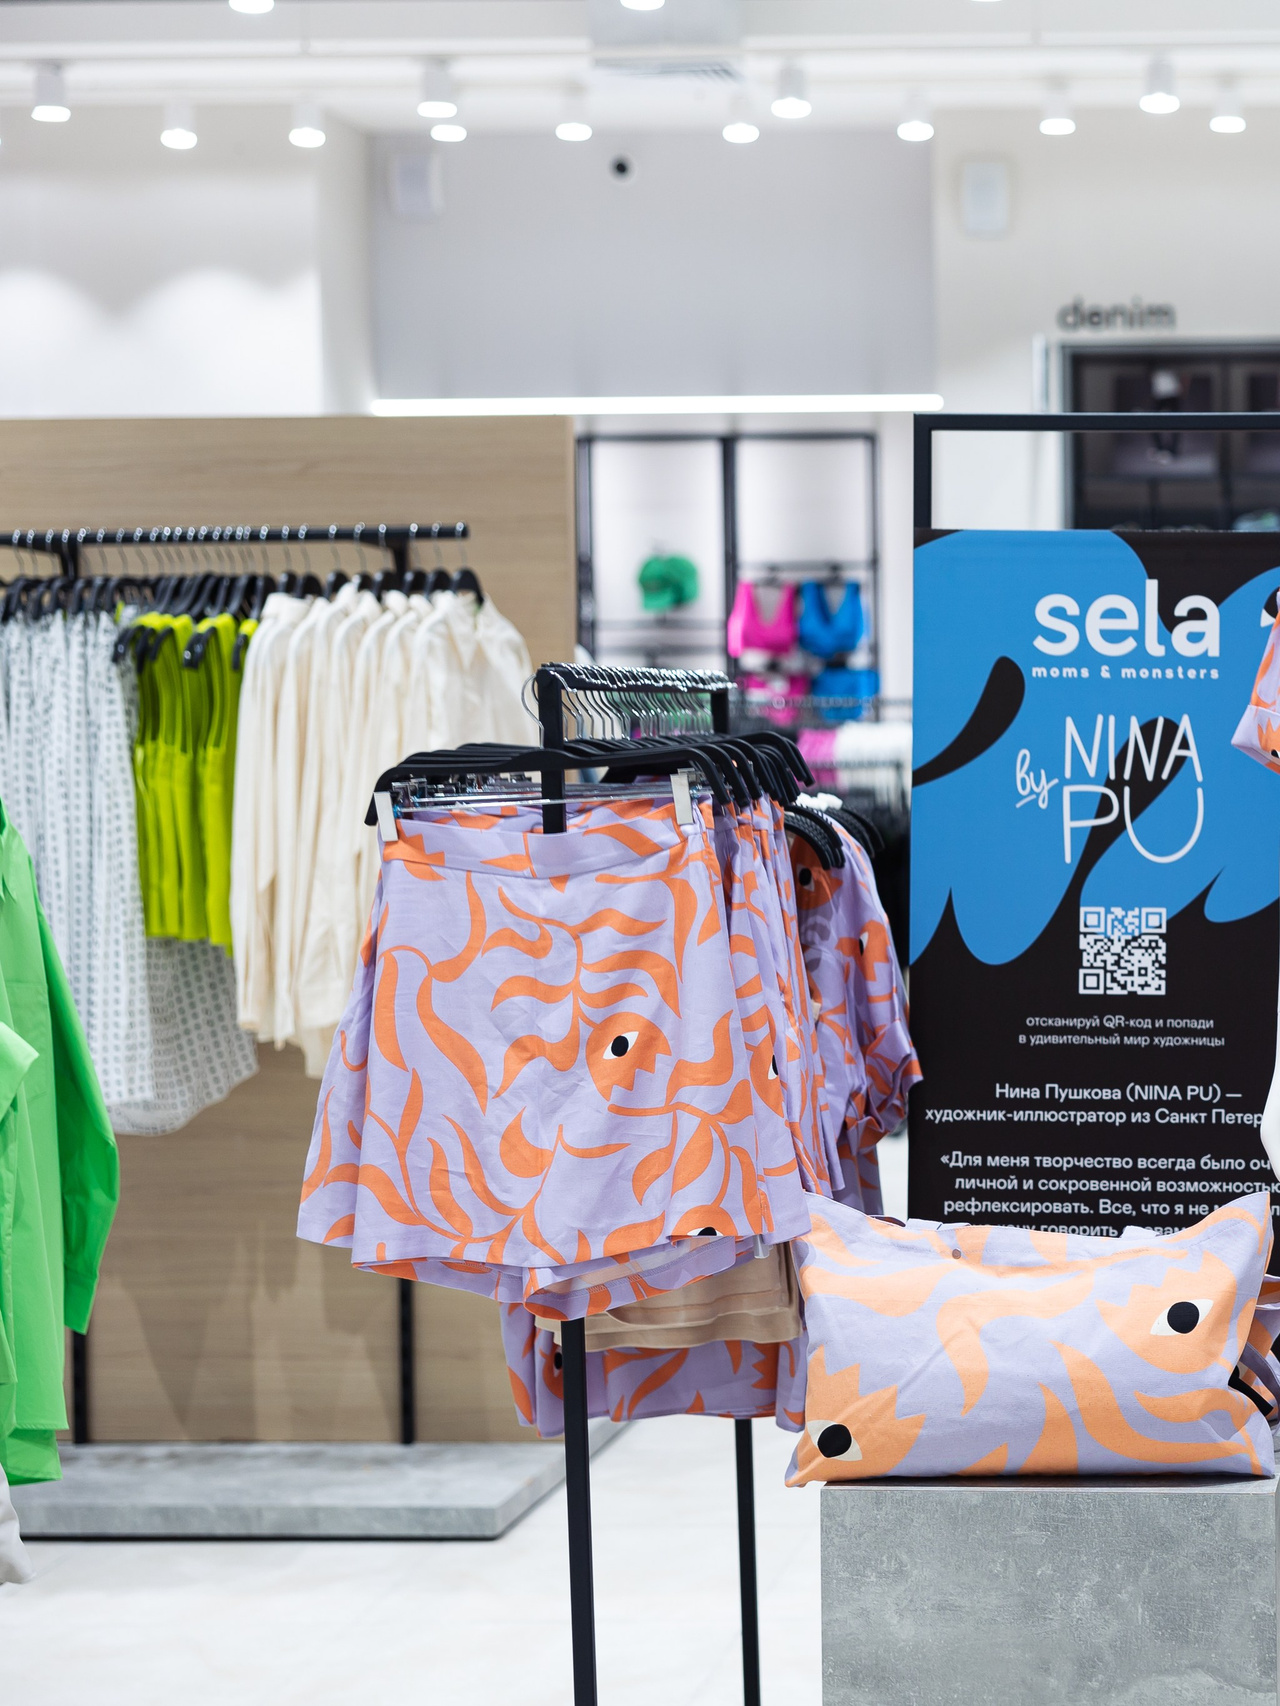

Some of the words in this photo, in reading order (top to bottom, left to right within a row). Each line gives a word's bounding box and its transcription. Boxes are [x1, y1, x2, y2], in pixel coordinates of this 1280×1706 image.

[1056, 295, 1176, 331] denim
[1032, 579, 1220, 657] sela
[1032, 666, 1090, 678] moms
[1100, 665, 1111, 678] &
[1121, 665, 1220, 679] monsters
[1016, 749, 1059, 809] by
[1064, 714, 1203, 782] NINA
[1062, 784, 1204, 864] PU
[1025, 1015, 1100, 1030] отсканируй
[1102, 1014, 1152, 1029] QR-код
[1155, 1018, 1164, 1028] и
[1166, 1018, 1214, 1029] попади
[1018, 1034, 1027, 1044] в
[1029, 1033, 1121, 1047] удивительный
[1123, 1035, 1151, 1047] мир
[1152, 1036, 1225, 1048] художницы
[995, 1082, 1041, 1099] Нина
[1045, 1083, 1122, 1103] Пушкова
[1125, 1082, 1183, 1103] (NINA
[1186, 1083, 1222, 1103] PU)
[925, 1109, 1127, 1127] художник-иллюстратор
[1130, 1111, 1151, 1124] из
[1154, 1107, 1208, 1125] Санкт
[940, 1150, 983, 1169] «Для
[986, 1155, 1030, 1168] меня
[1033, 1156, 1133, 1172] творчество
[1137, 1157, 1196, 1172] всегда
[1200, 1153, 1246, 1171] было
[954, 1175, 1018, 1190] личной
[1022, 1178, 1034, 1190] и
[1037, 1176, 1152, 1195] сокровенной
[943, 1197, 1094, 1217] рефлексировать.
[1098, 1198, 1137, 1217] Все,
[1140, 1203, 1171, 1215] что
[1174, 1203, 1184, 1215] я
[1188, 1203, 1210, 1216] не
